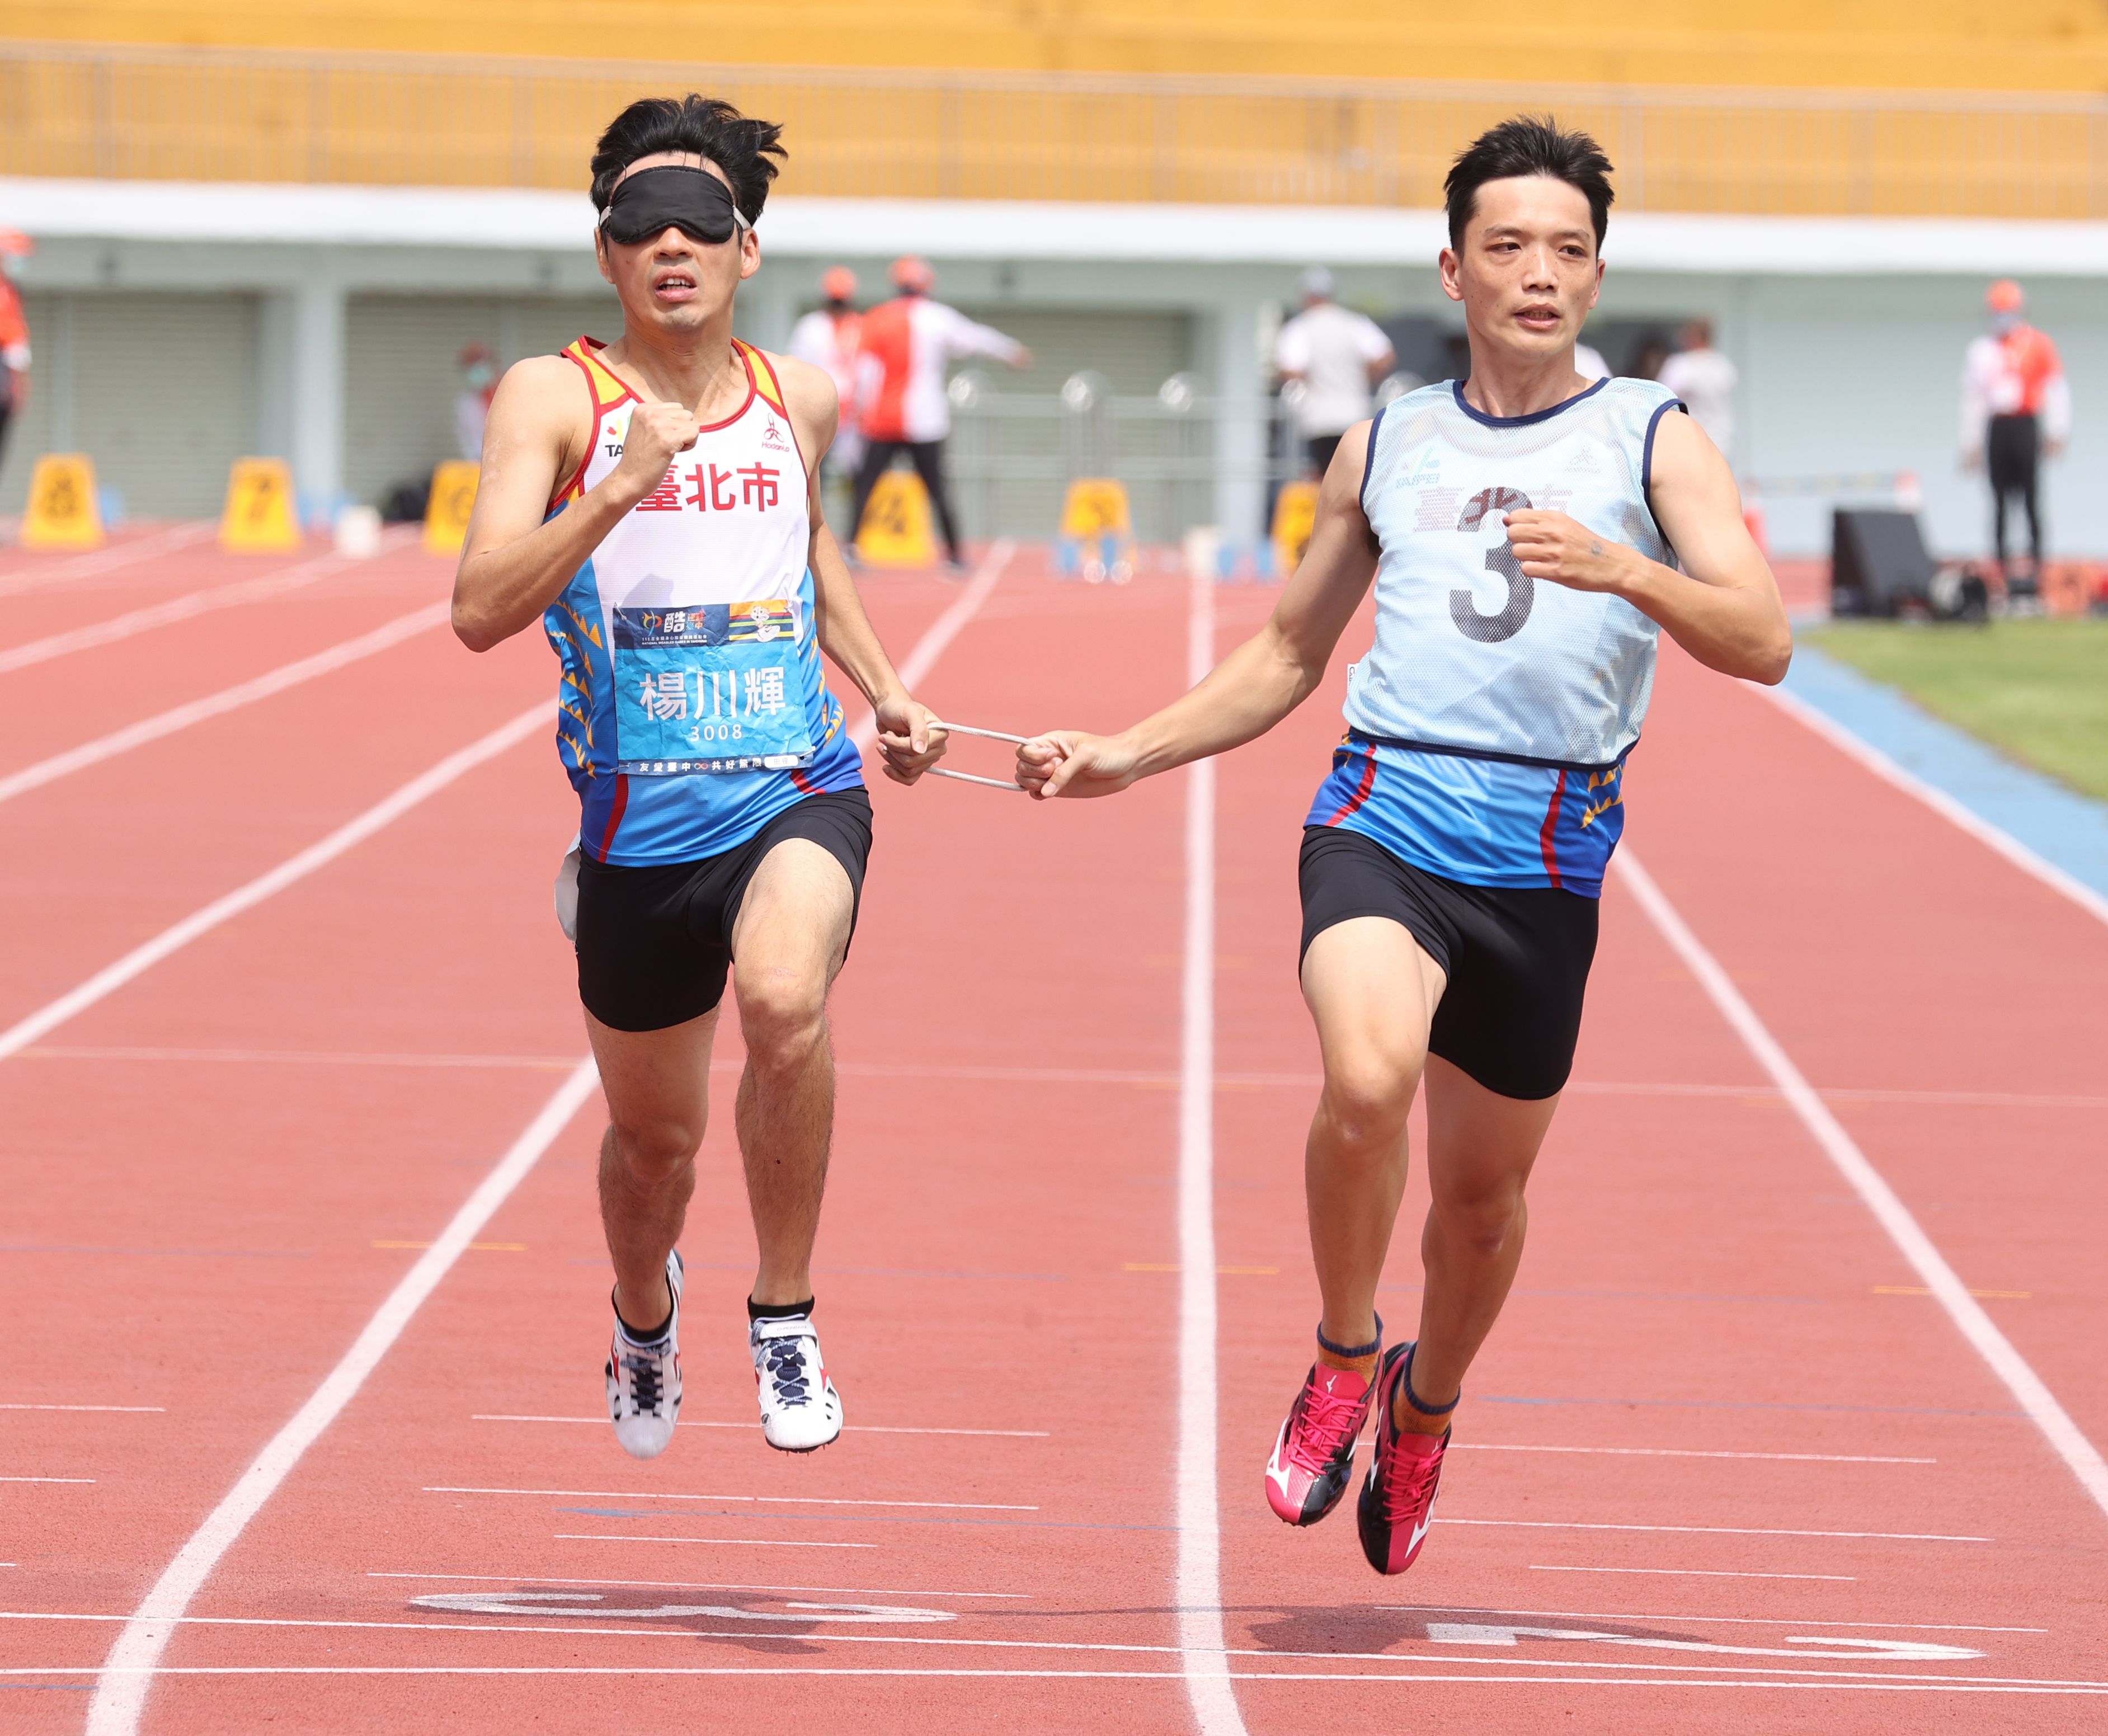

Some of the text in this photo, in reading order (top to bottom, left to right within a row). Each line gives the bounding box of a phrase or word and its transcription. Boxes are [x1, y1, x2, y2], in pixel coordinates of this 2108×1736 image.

[1449, 487, 1535, 643] 3
[639, 666, 786, 721] 楊川輝
[690, 723, 743, 742] 3008
